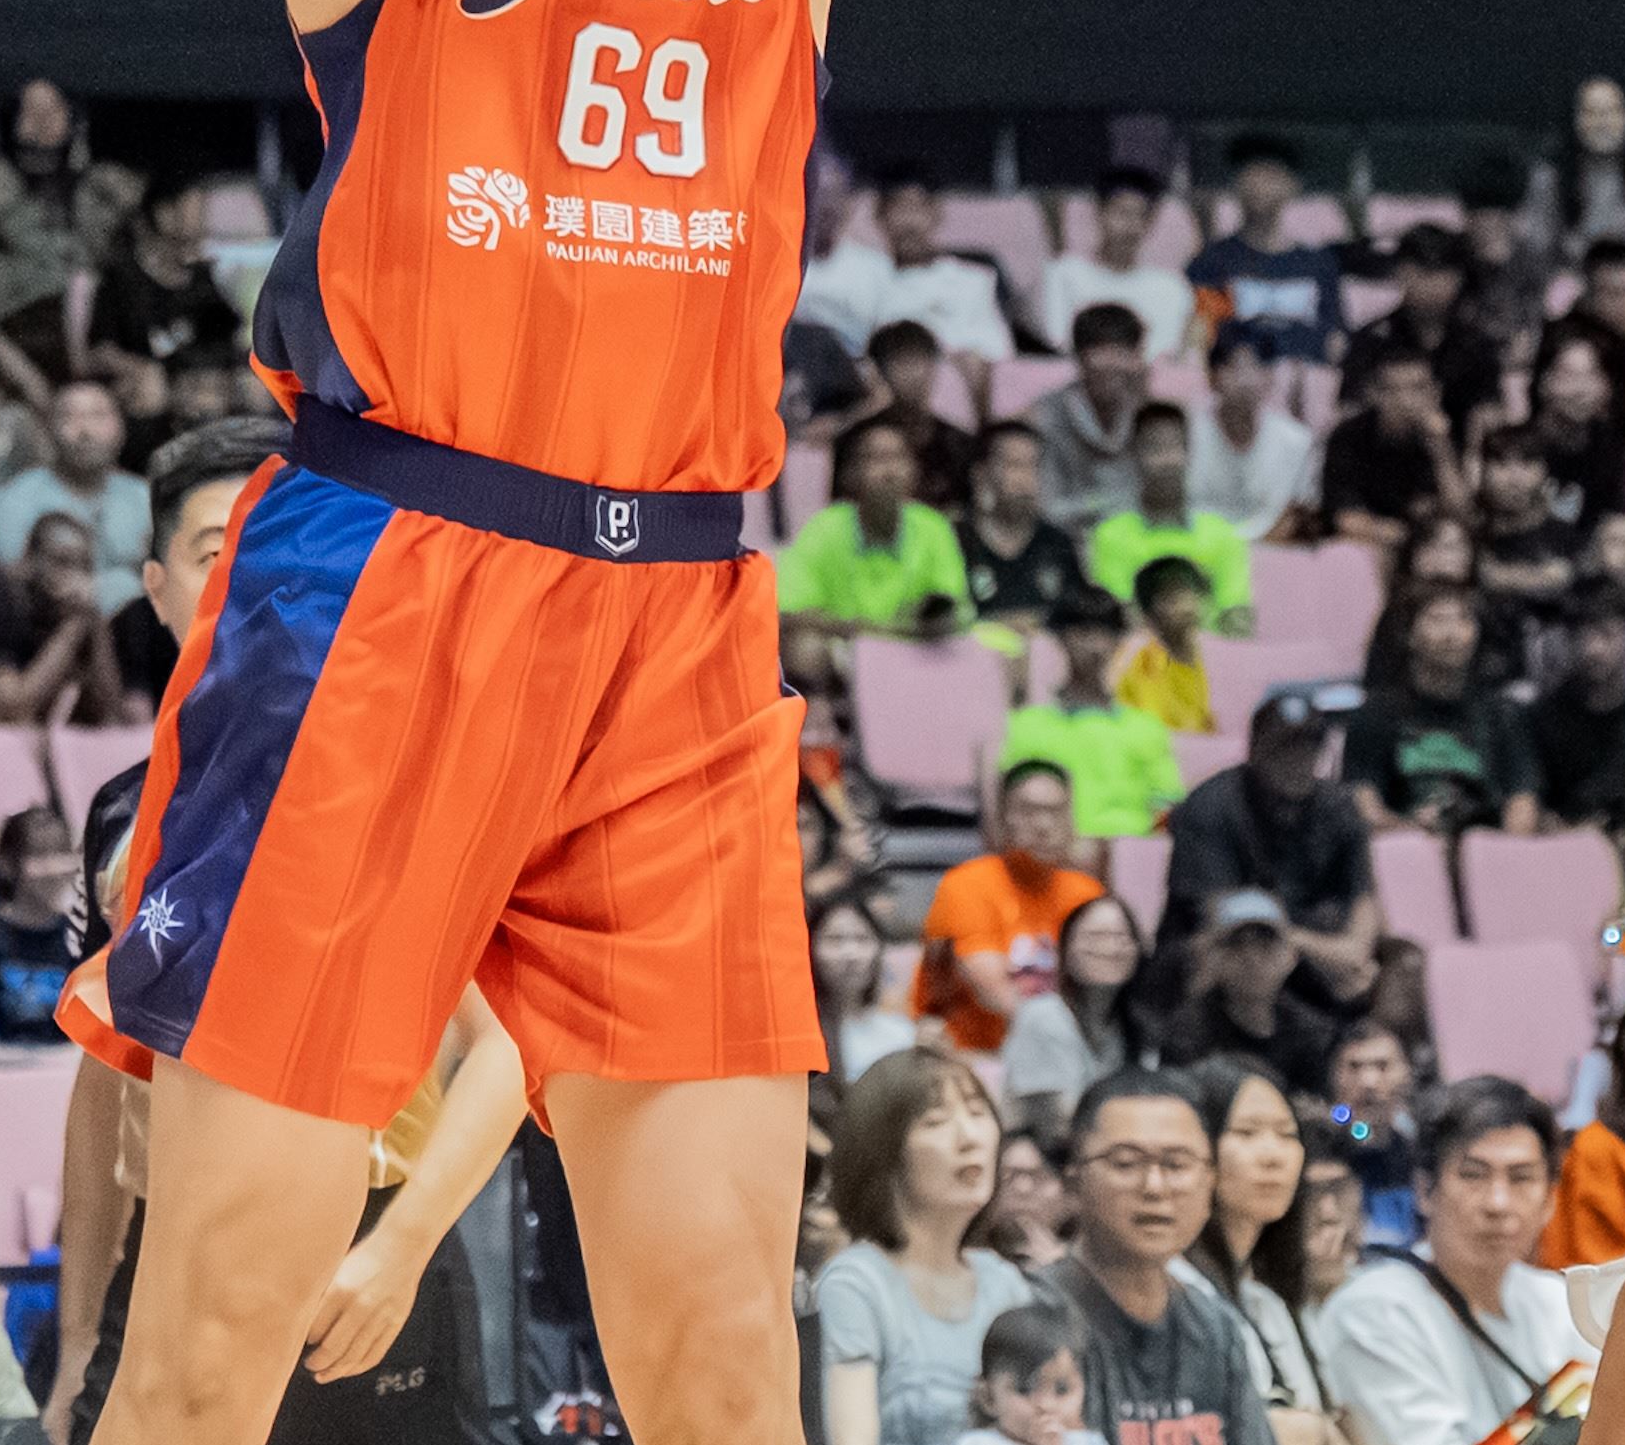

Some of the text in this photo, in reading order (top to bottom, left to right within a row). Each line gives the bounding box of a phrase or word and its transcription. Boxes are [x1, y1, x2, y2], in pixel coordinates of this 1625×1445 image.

[557, 21, 712, 179] 69
[543, 194, 748, 252] 璞園建築
[546, 240, 733, 278] PAUIAN ARCHILAND
